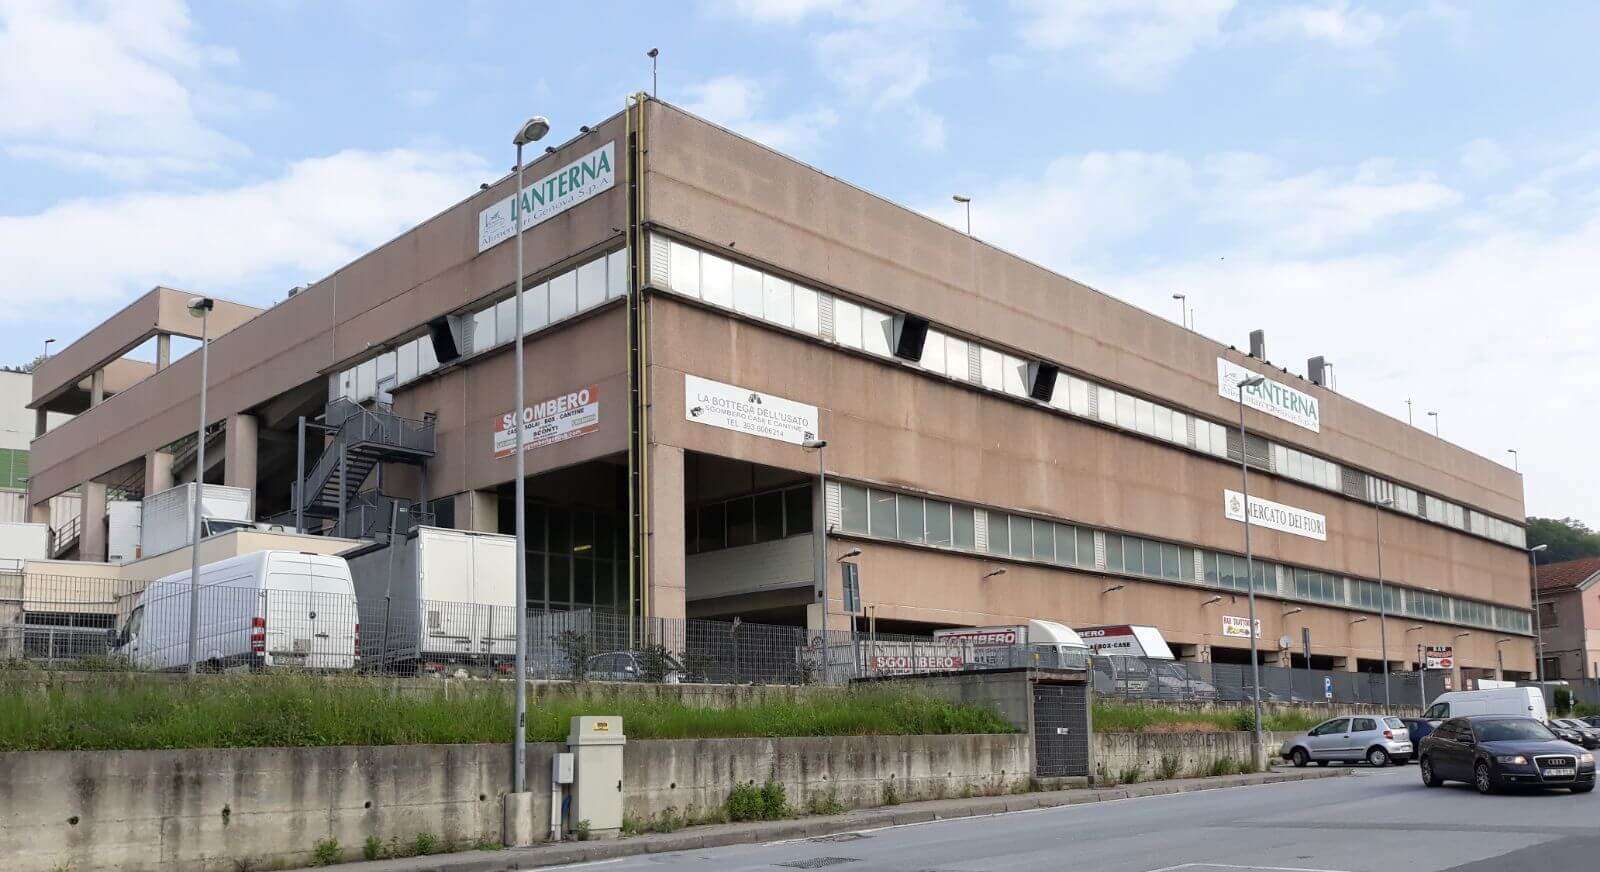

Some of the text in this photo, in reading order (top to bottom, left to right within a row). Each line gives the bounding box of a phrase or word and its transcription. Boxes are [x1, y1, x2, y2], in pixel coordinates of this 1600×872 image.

[511, 150, 610, 221] LANTERNA
[559, 407, 585, 420] CANTINE
[697, 393, 809, 427] LA BOTTEGA DELL'USATO
[705, 405, 748, 420] SGOMBERO
[1247, 502, 1325, 535] MERCATO DEI FIORI
